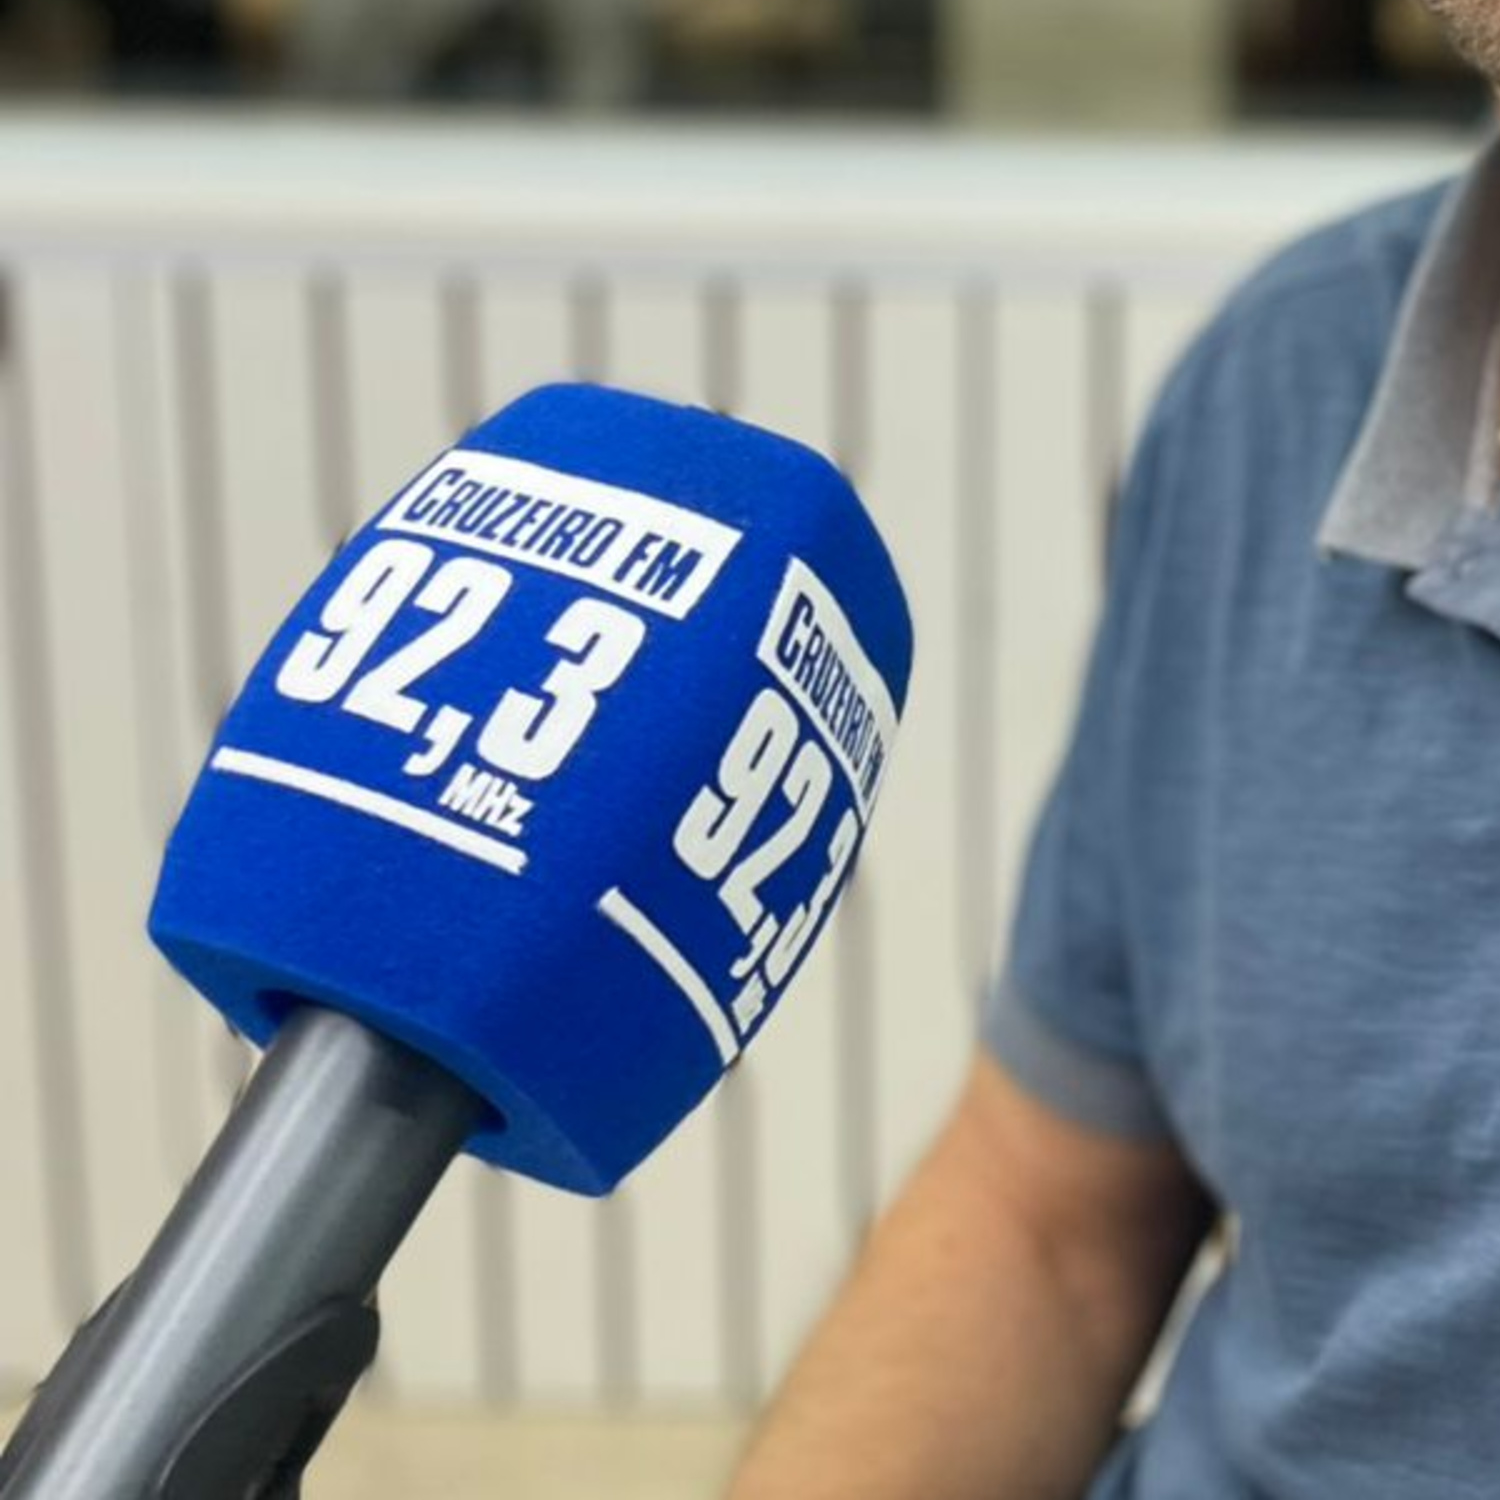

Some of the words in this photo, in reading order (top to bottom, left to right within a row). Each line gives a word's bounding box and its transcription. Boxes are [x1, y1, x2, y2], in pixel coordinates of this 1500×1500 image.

[402, 468, 624, 568] CRUZEIRO
[612, 532, 703, 602] FM
[275, 538, 646, 780] 92,3
[776, 591, 875, 772] CRUZEIRO
[437, 763, 534, 837] MHz
